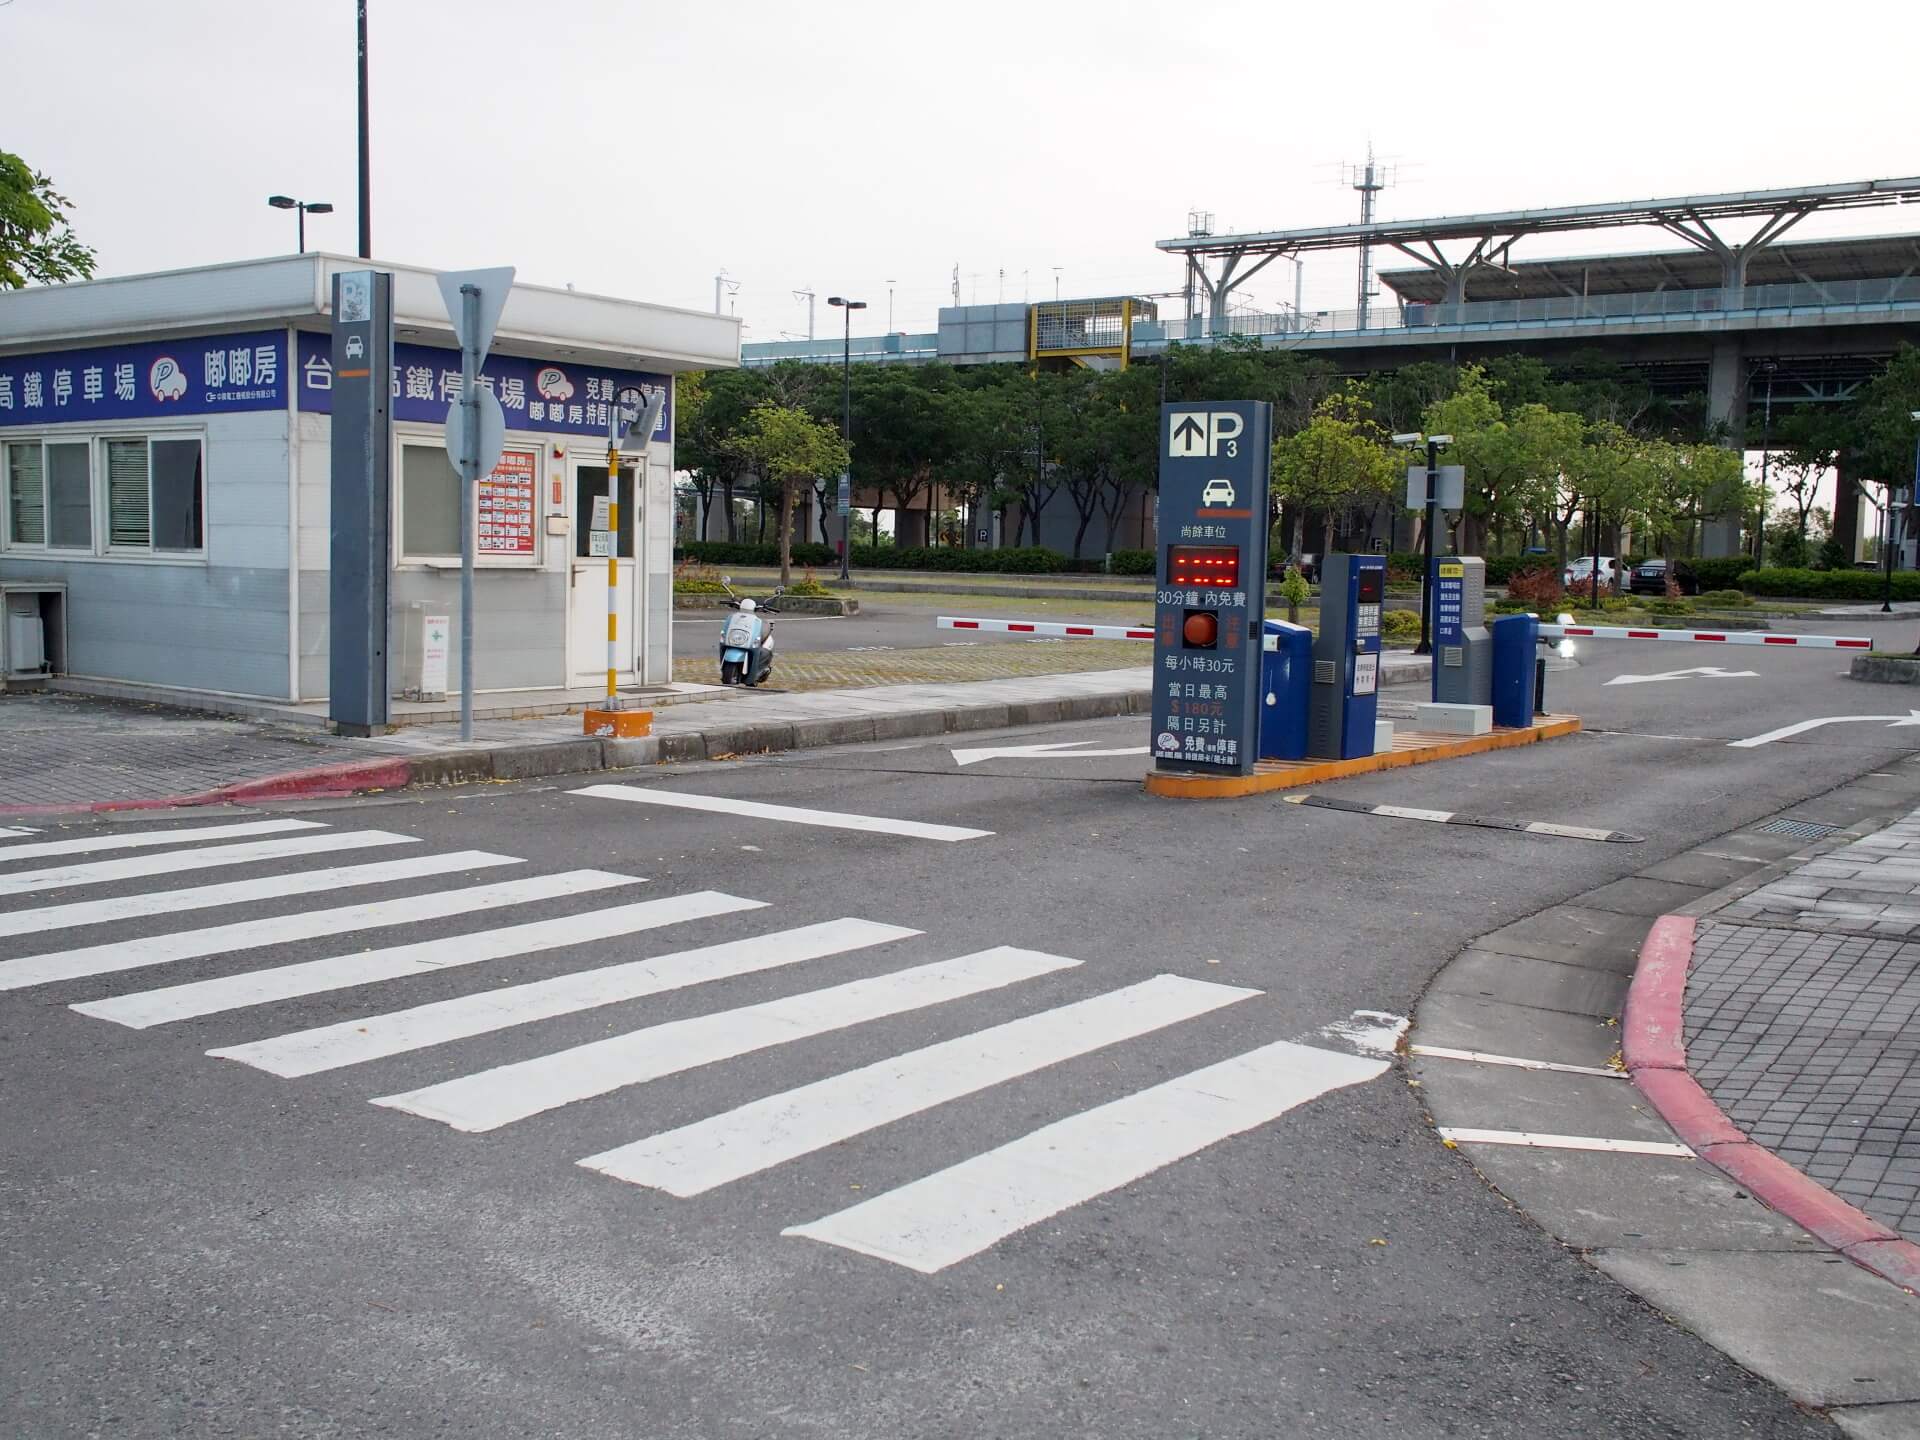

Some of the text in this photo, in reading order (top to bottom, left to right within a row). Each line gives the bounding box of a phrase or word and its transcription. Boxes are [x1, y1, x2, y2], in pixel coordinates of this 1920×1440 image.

[204, 345, 276, 388] 嘟嘟房
[586, 377, 615, 402] 免費
[529, 401, 583, 426] 嘟嘟房
[1209, 412, 1244, 458] P3
[1181, 525, 1227, 539] 尚餘車位
[1165, 655, 1235, 673] 每小時30元
[1168, 681, 1228, 700] 當日最高
[1167, 716, 1227, 735] 隔日另計
